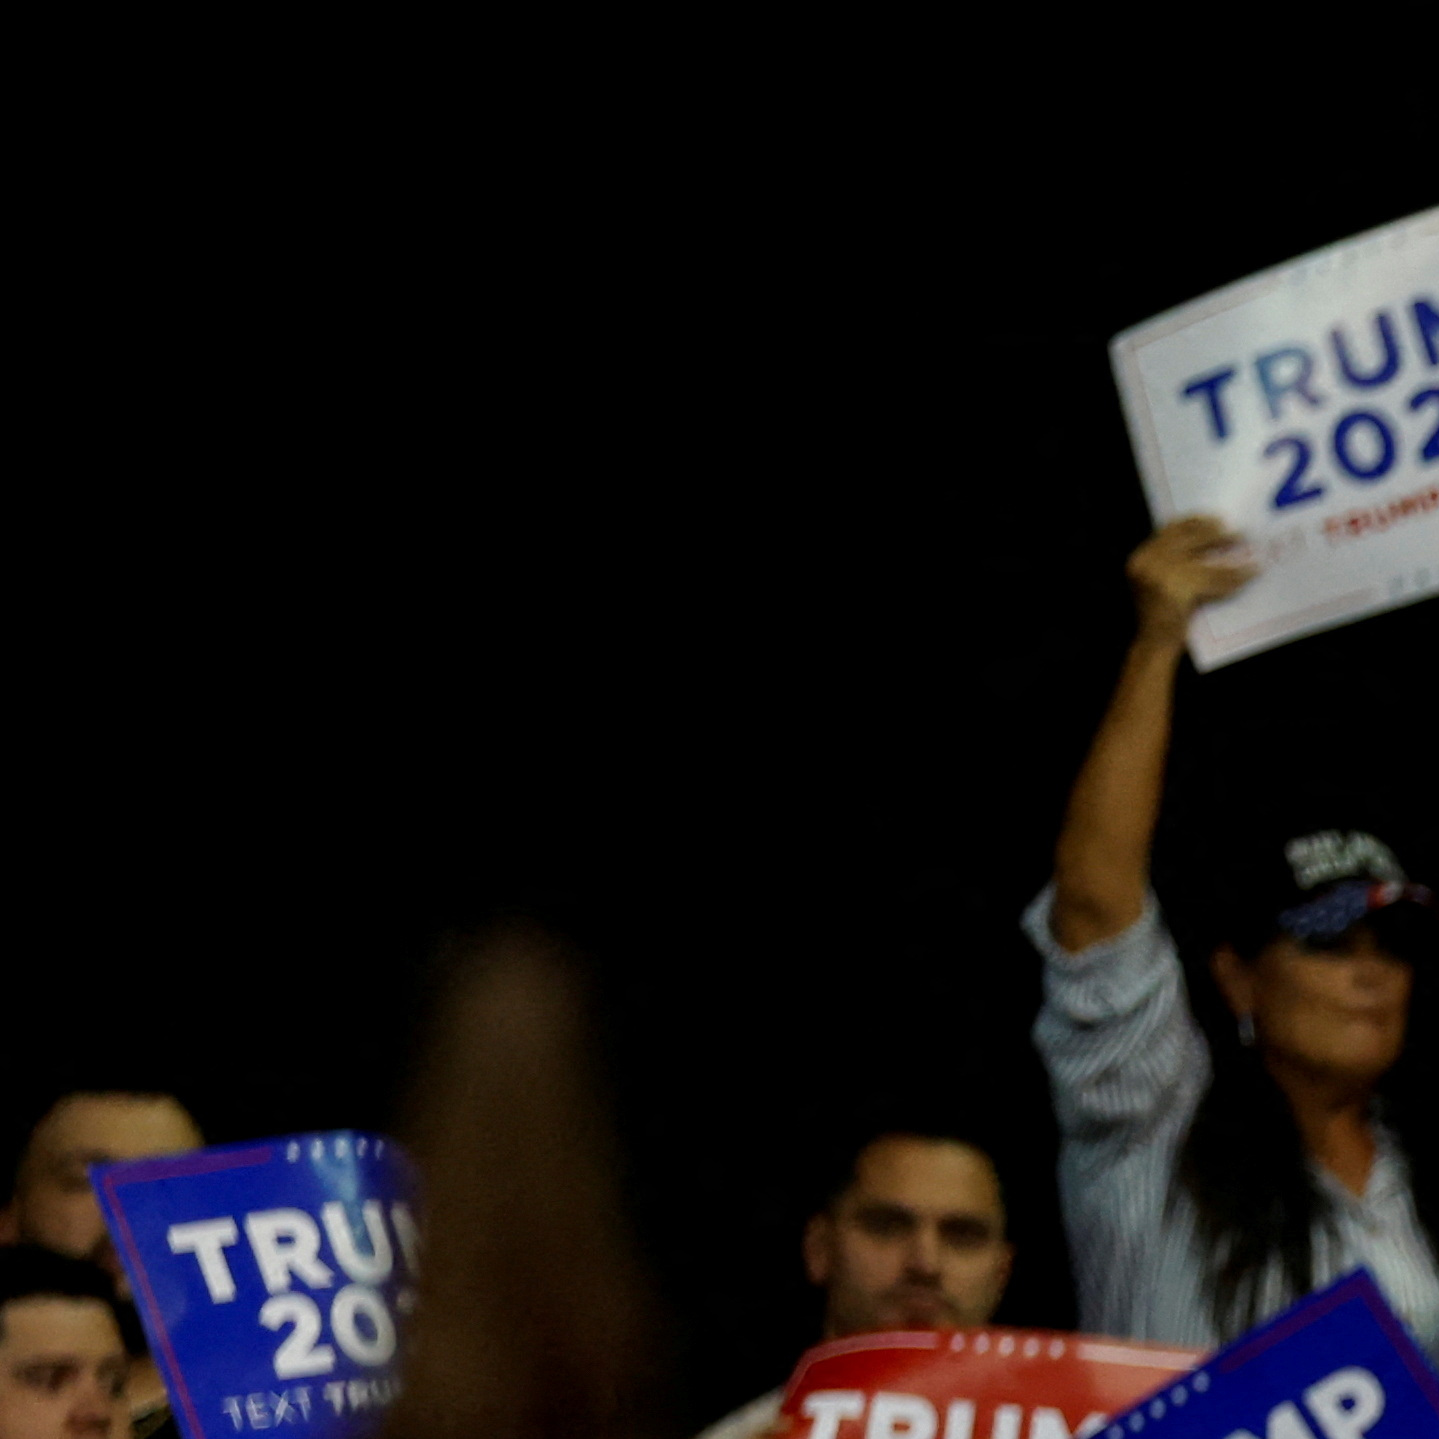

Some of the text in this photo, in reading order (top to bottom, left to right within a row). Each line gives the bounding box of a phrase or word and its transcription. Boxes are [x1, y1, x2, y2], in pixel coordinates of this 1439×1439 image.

[167, 1200, 421, 1304] TRU
[259, 1284, 400, 1380] 20
[222, 1385, 314, 1432] TEXT
